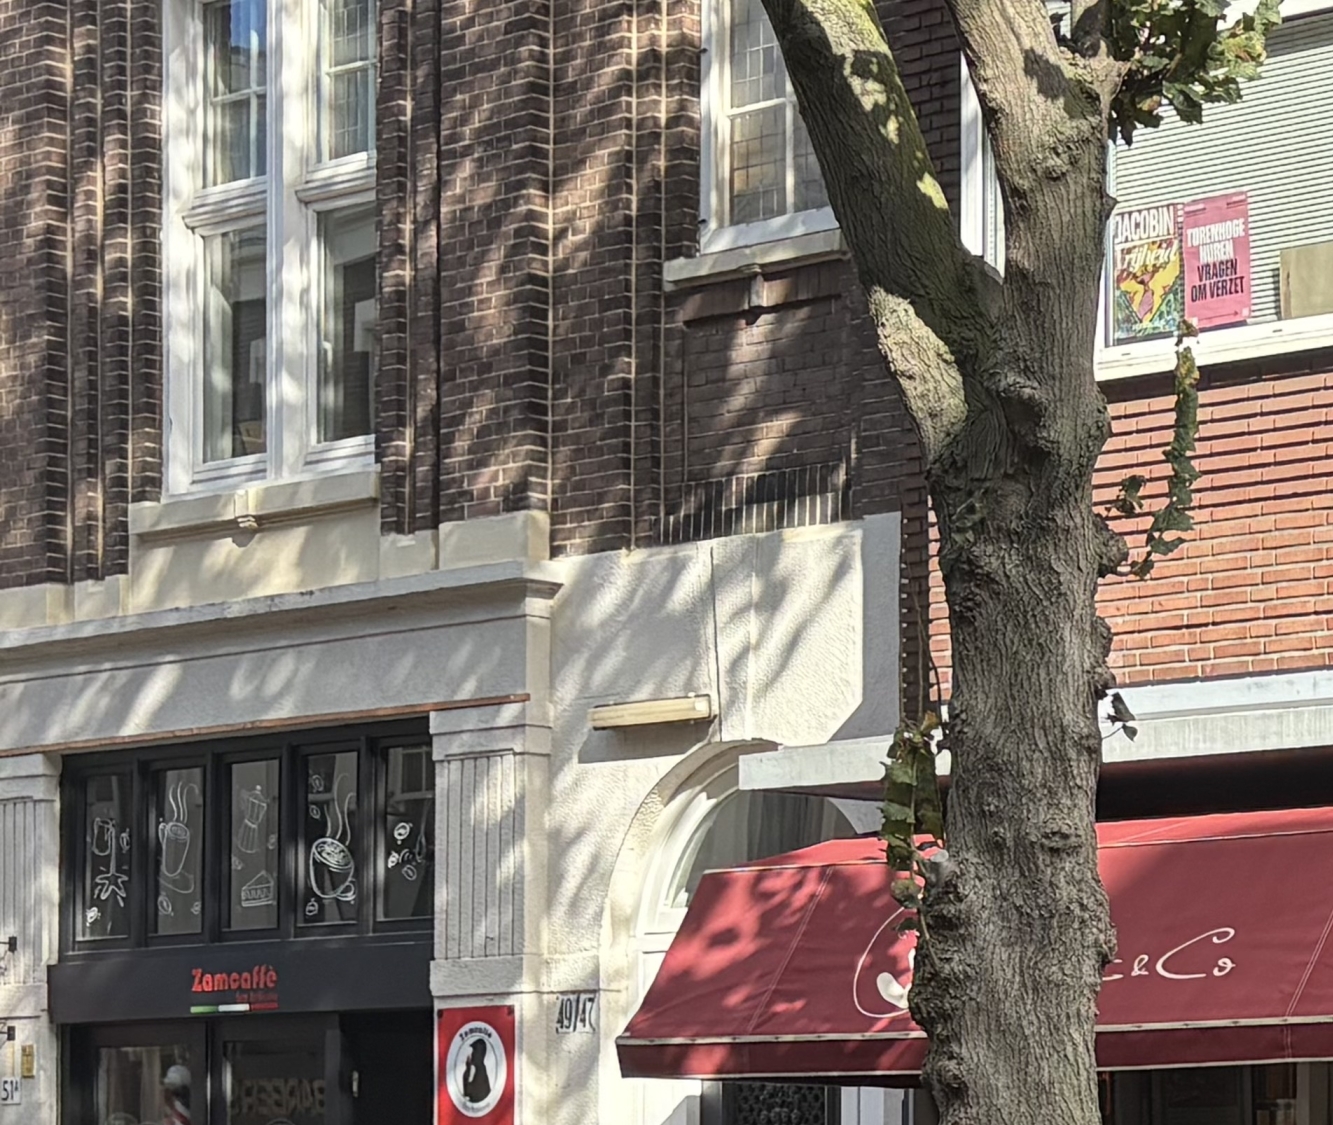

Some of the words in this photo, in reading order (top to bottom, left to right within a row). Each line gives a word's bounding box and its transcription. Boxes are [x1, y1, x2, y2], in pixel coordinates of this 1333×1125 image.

[1114, 205, 1175, 243] JACOBIN
[1186, 218, 1246, 247] TORENHOGE
[1199, 240, 1235, 264] HUREN
[1197, 258, 1238, 283] VRAGEN
[1190, 283, 1208, 303] OM
[1209, 276, 1246, 300] VERZET
[1131, 953, 1150, 977] &
[1155, 926, 1236, 980] Co
